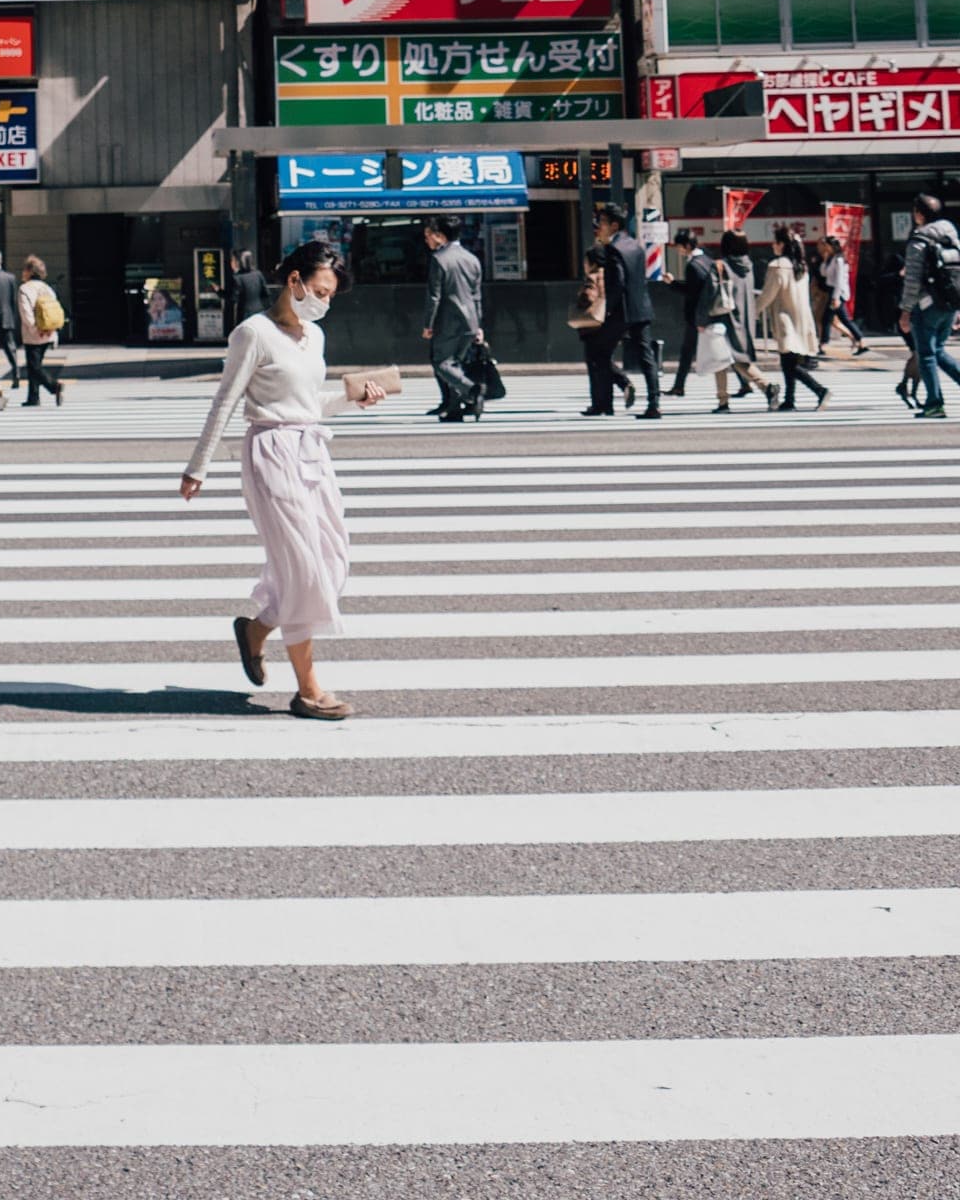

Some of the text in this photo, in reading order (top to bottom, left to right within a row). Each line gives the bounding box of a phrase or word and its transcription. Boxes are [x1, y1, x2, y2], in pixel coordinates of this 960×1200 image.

[279, 37, 618, 78] くすり 処方せん受付
[768, 91, 941, 131] ヘヤギメ
[287, 155, 514, 188] トーシン薬局
